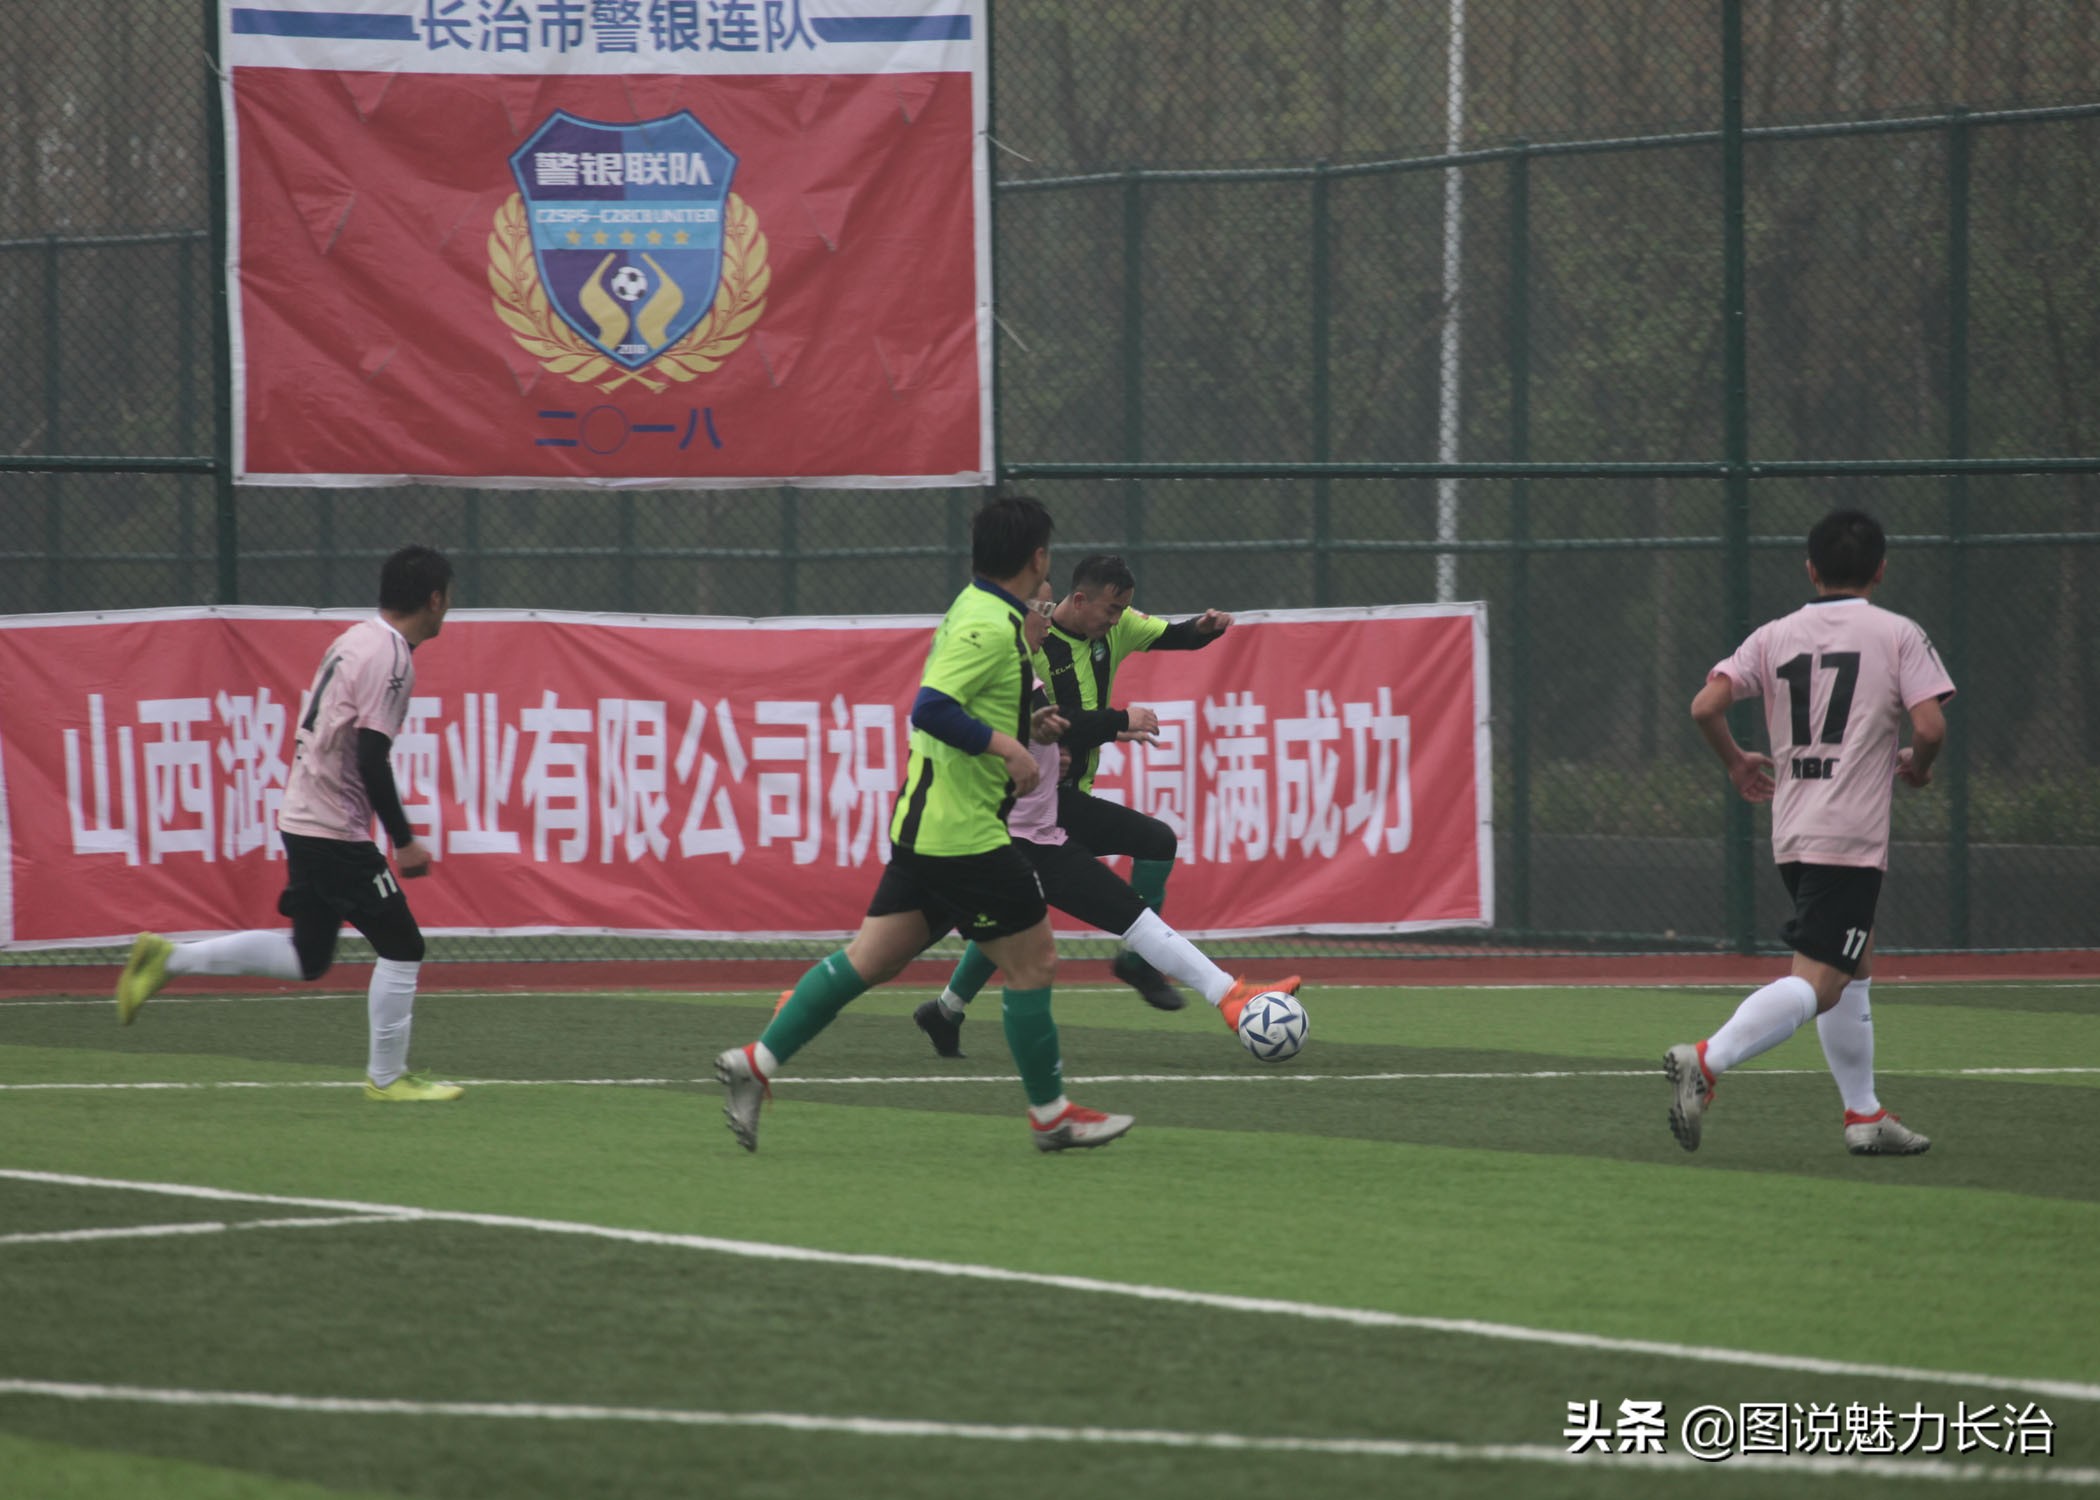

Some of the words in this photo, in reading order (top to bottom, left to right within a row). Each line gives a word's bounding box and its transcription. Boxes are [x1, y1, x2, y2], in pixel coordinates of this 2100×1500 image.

[420, 0, 816, 53] 长治市警银连队
[534, 152, 713, 186] 警银联队
[1776, 652, 1861, 746] 17
[373, 868, 398, 899] 11
[1842, 927, 1868, 961] 17
